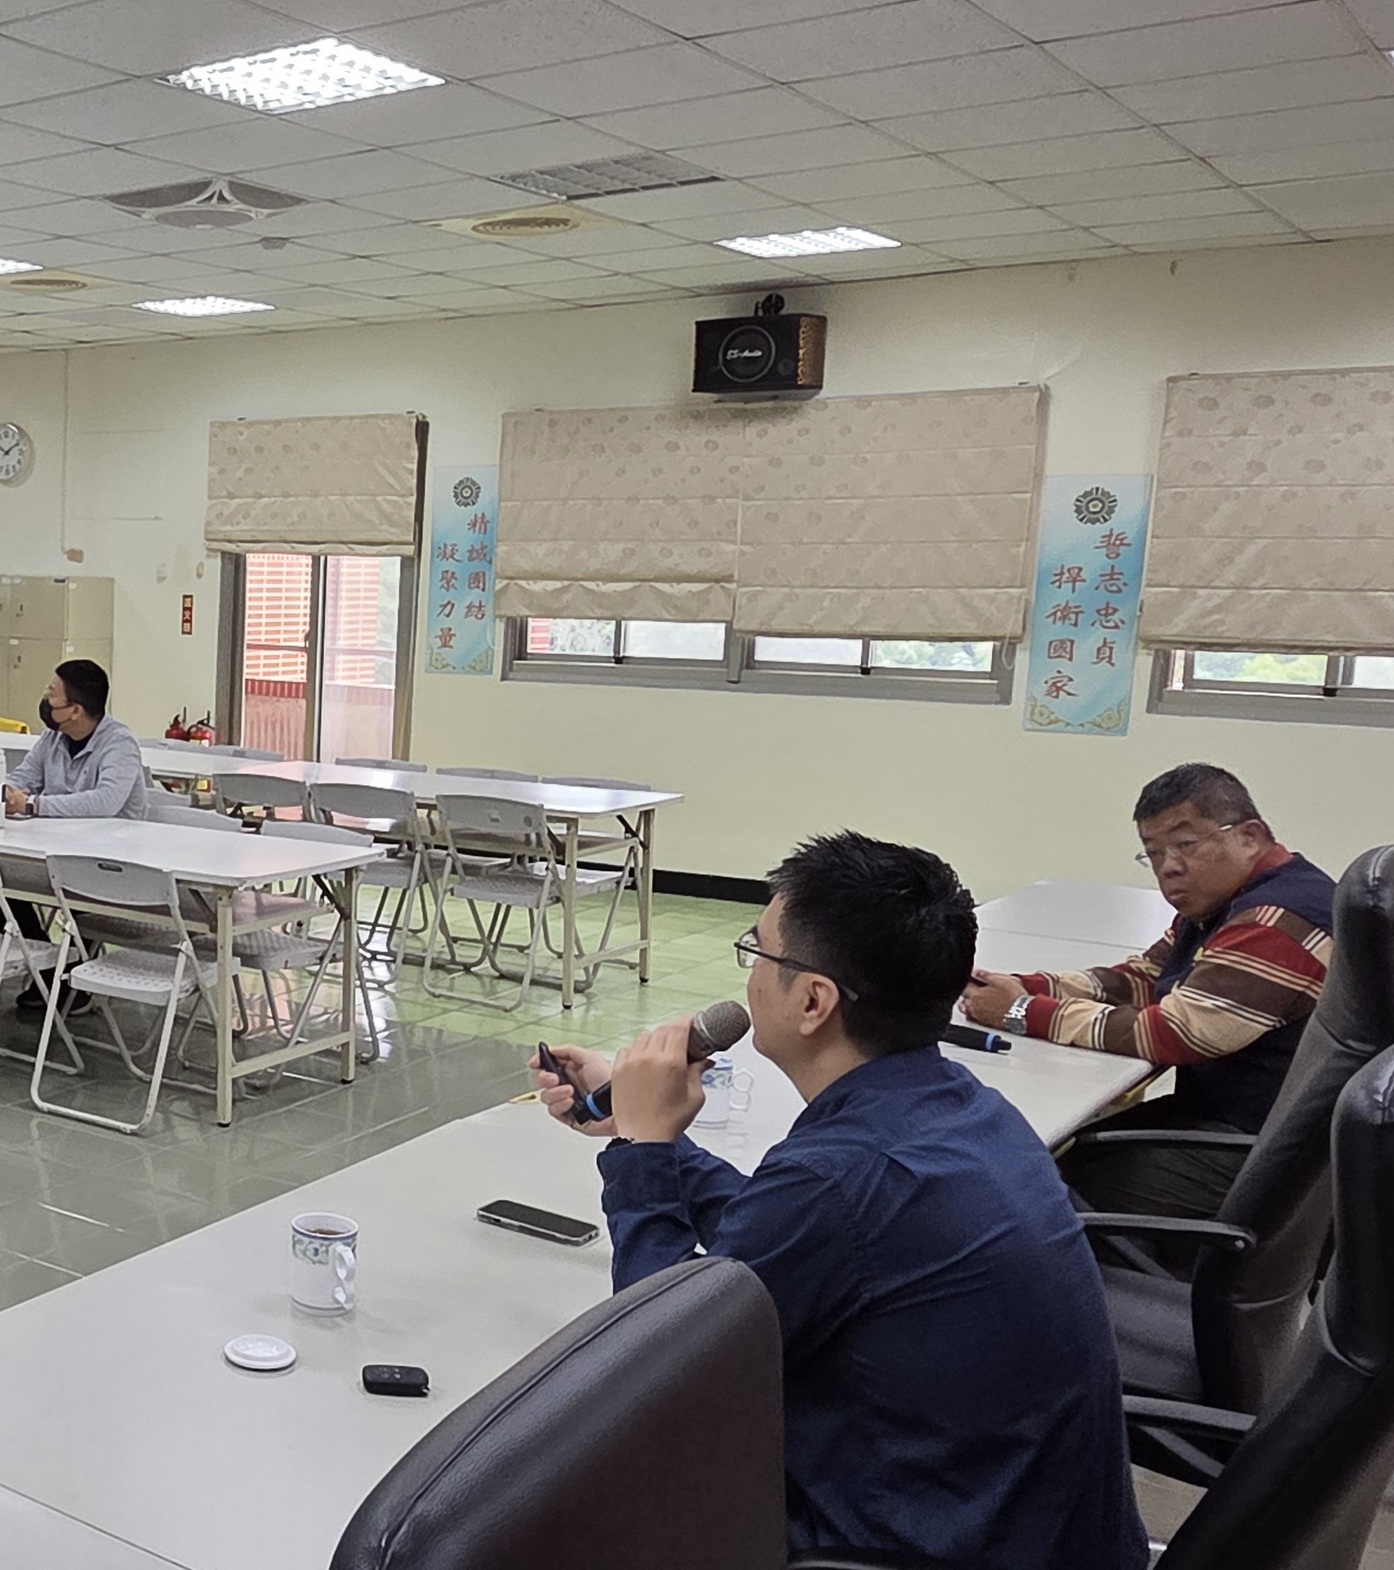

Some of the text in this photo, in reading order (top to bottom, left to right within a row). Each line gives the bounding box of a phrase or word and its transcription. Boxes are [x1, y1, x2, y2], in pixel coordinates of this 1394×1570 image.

[435, 543, 462, 649] 凝聚力量
[464, 512, 493, 621] 精誠團結
[1090, 528, 1132, 667] 誓志忠貞
